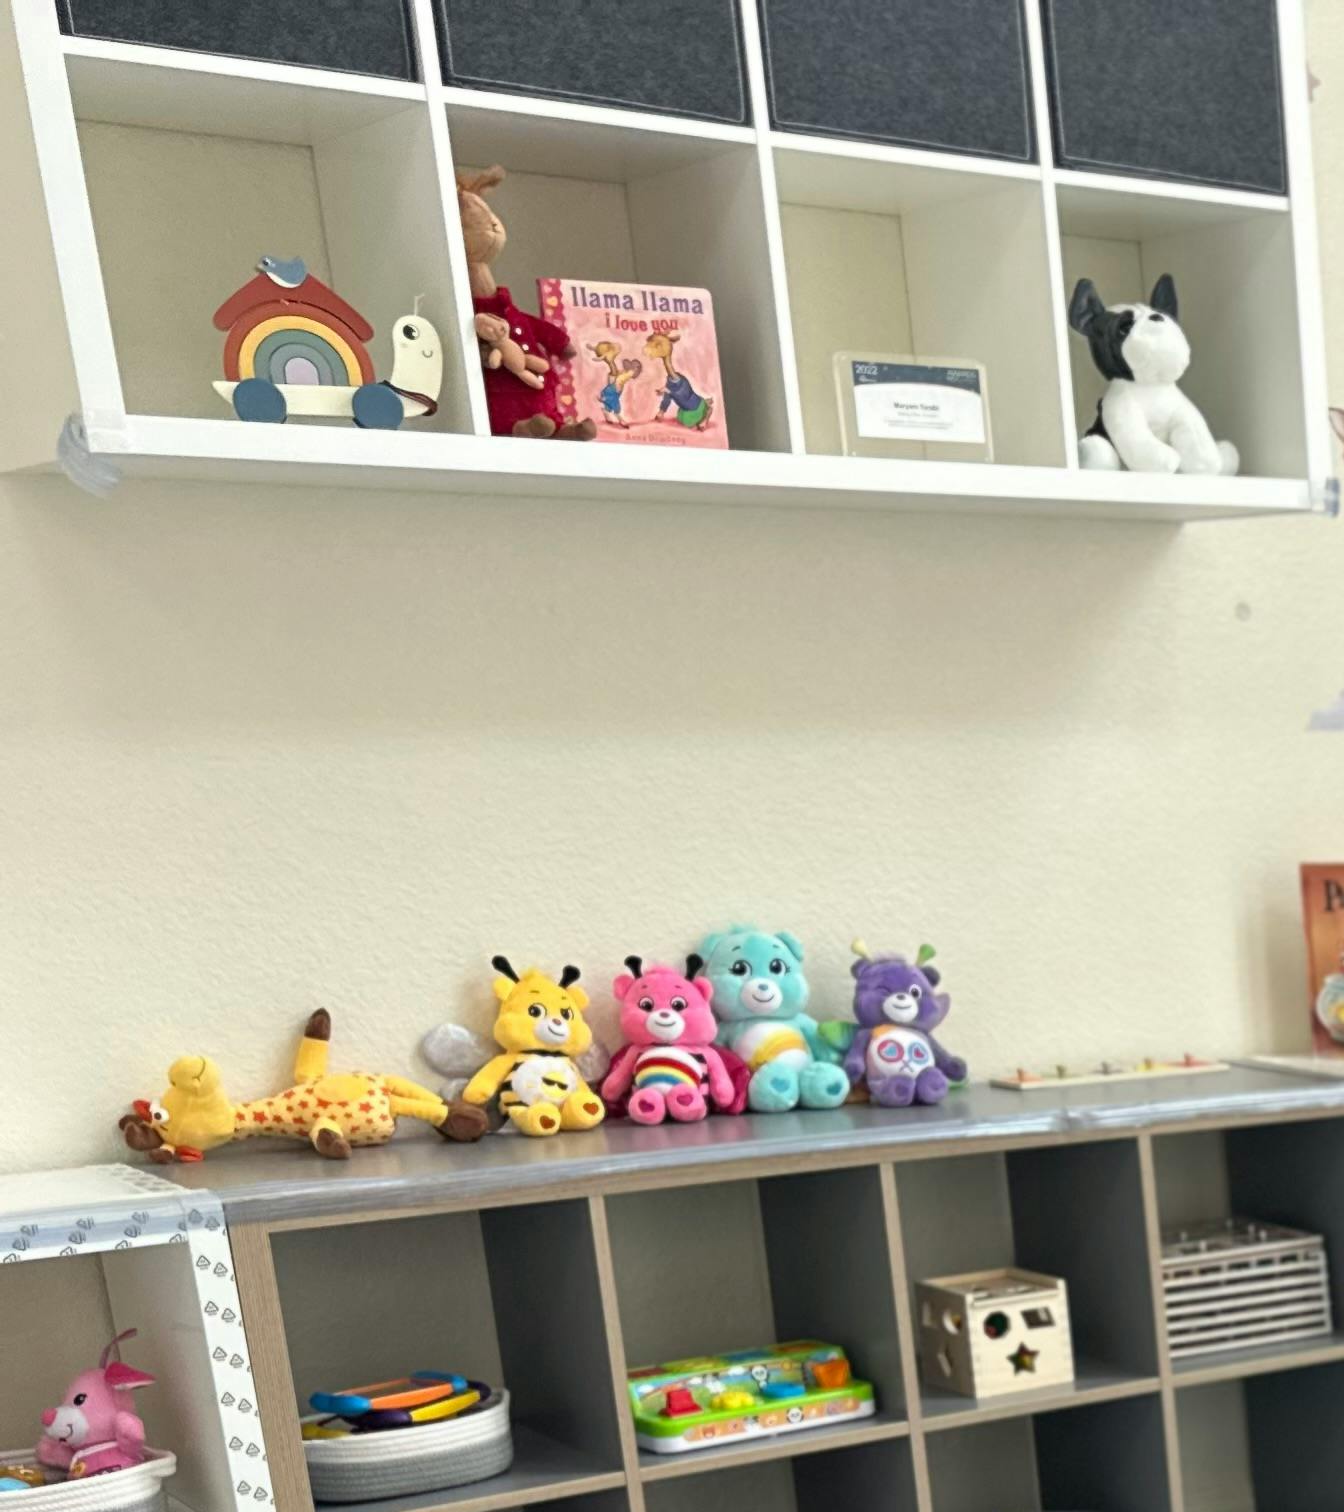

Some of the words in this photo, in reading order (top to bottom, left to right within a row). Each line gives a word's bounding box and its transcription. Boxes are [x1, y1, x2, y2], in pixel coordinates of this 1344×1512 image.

[571, 286, 635, 309] llama
[641, 291, 705, 315] llama
[605, 313, 612, 329] i
[616, 315, 648, 332] love
[651, 319, 679, 335] you
